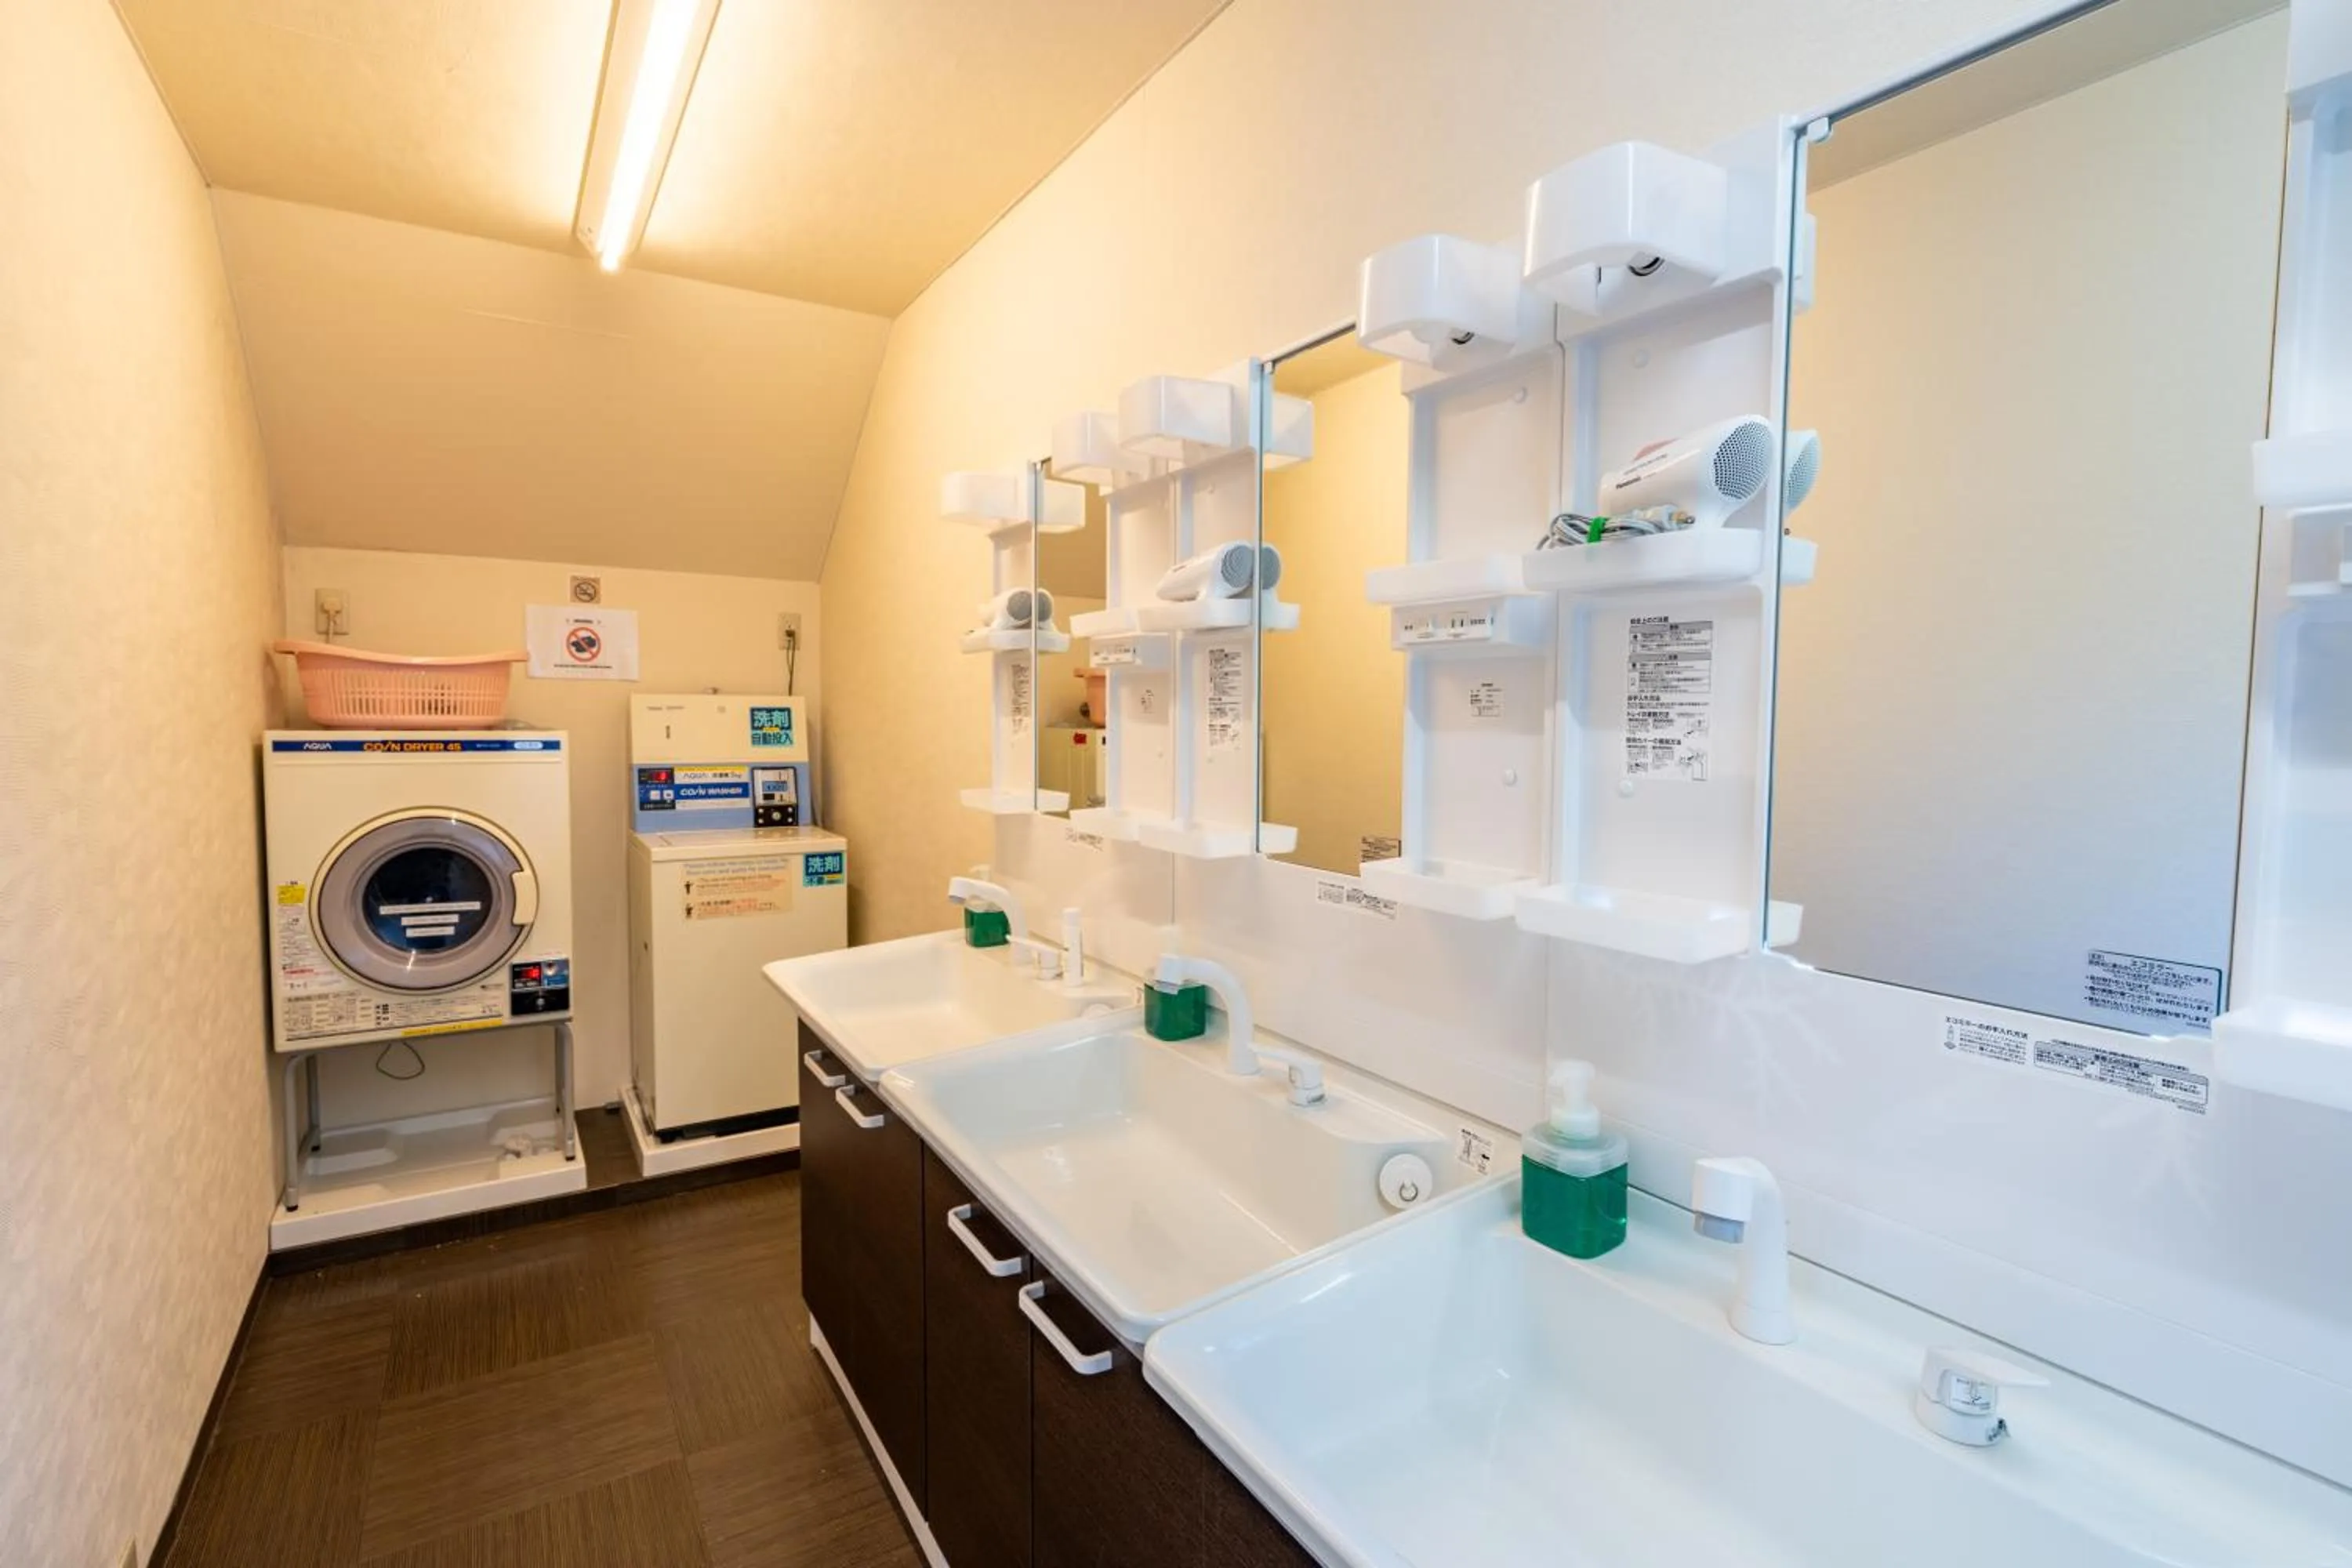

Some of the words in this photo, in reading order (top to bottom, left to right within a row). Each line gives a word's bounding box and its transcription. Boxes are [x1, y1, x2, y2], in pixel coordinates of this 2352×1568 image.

[753, 710, 789, 728] 洗剤
[403, 742, 444, 752] DRYER
[808, 855, 840, 873] 洗剤
